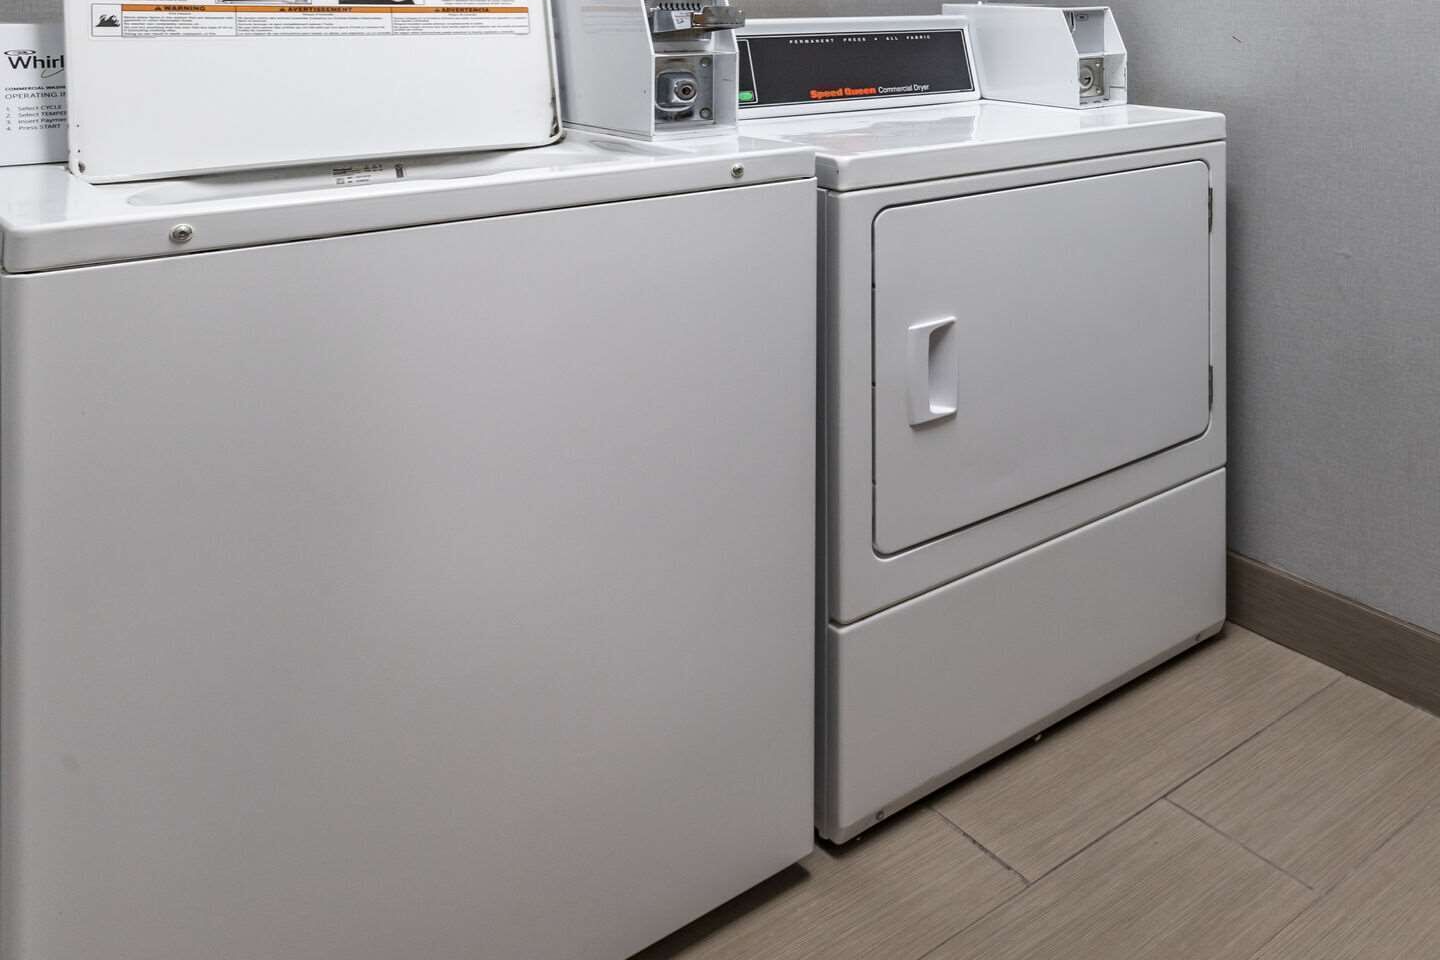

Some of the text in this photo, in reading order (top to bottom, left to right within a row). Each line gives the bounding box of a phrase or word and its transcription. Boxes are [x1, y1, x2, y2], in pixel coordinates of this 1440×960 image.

[5, 92, 57, 100] OPERATING
[810, 83, 930, 100] Speed Queen Commercial Dryer
